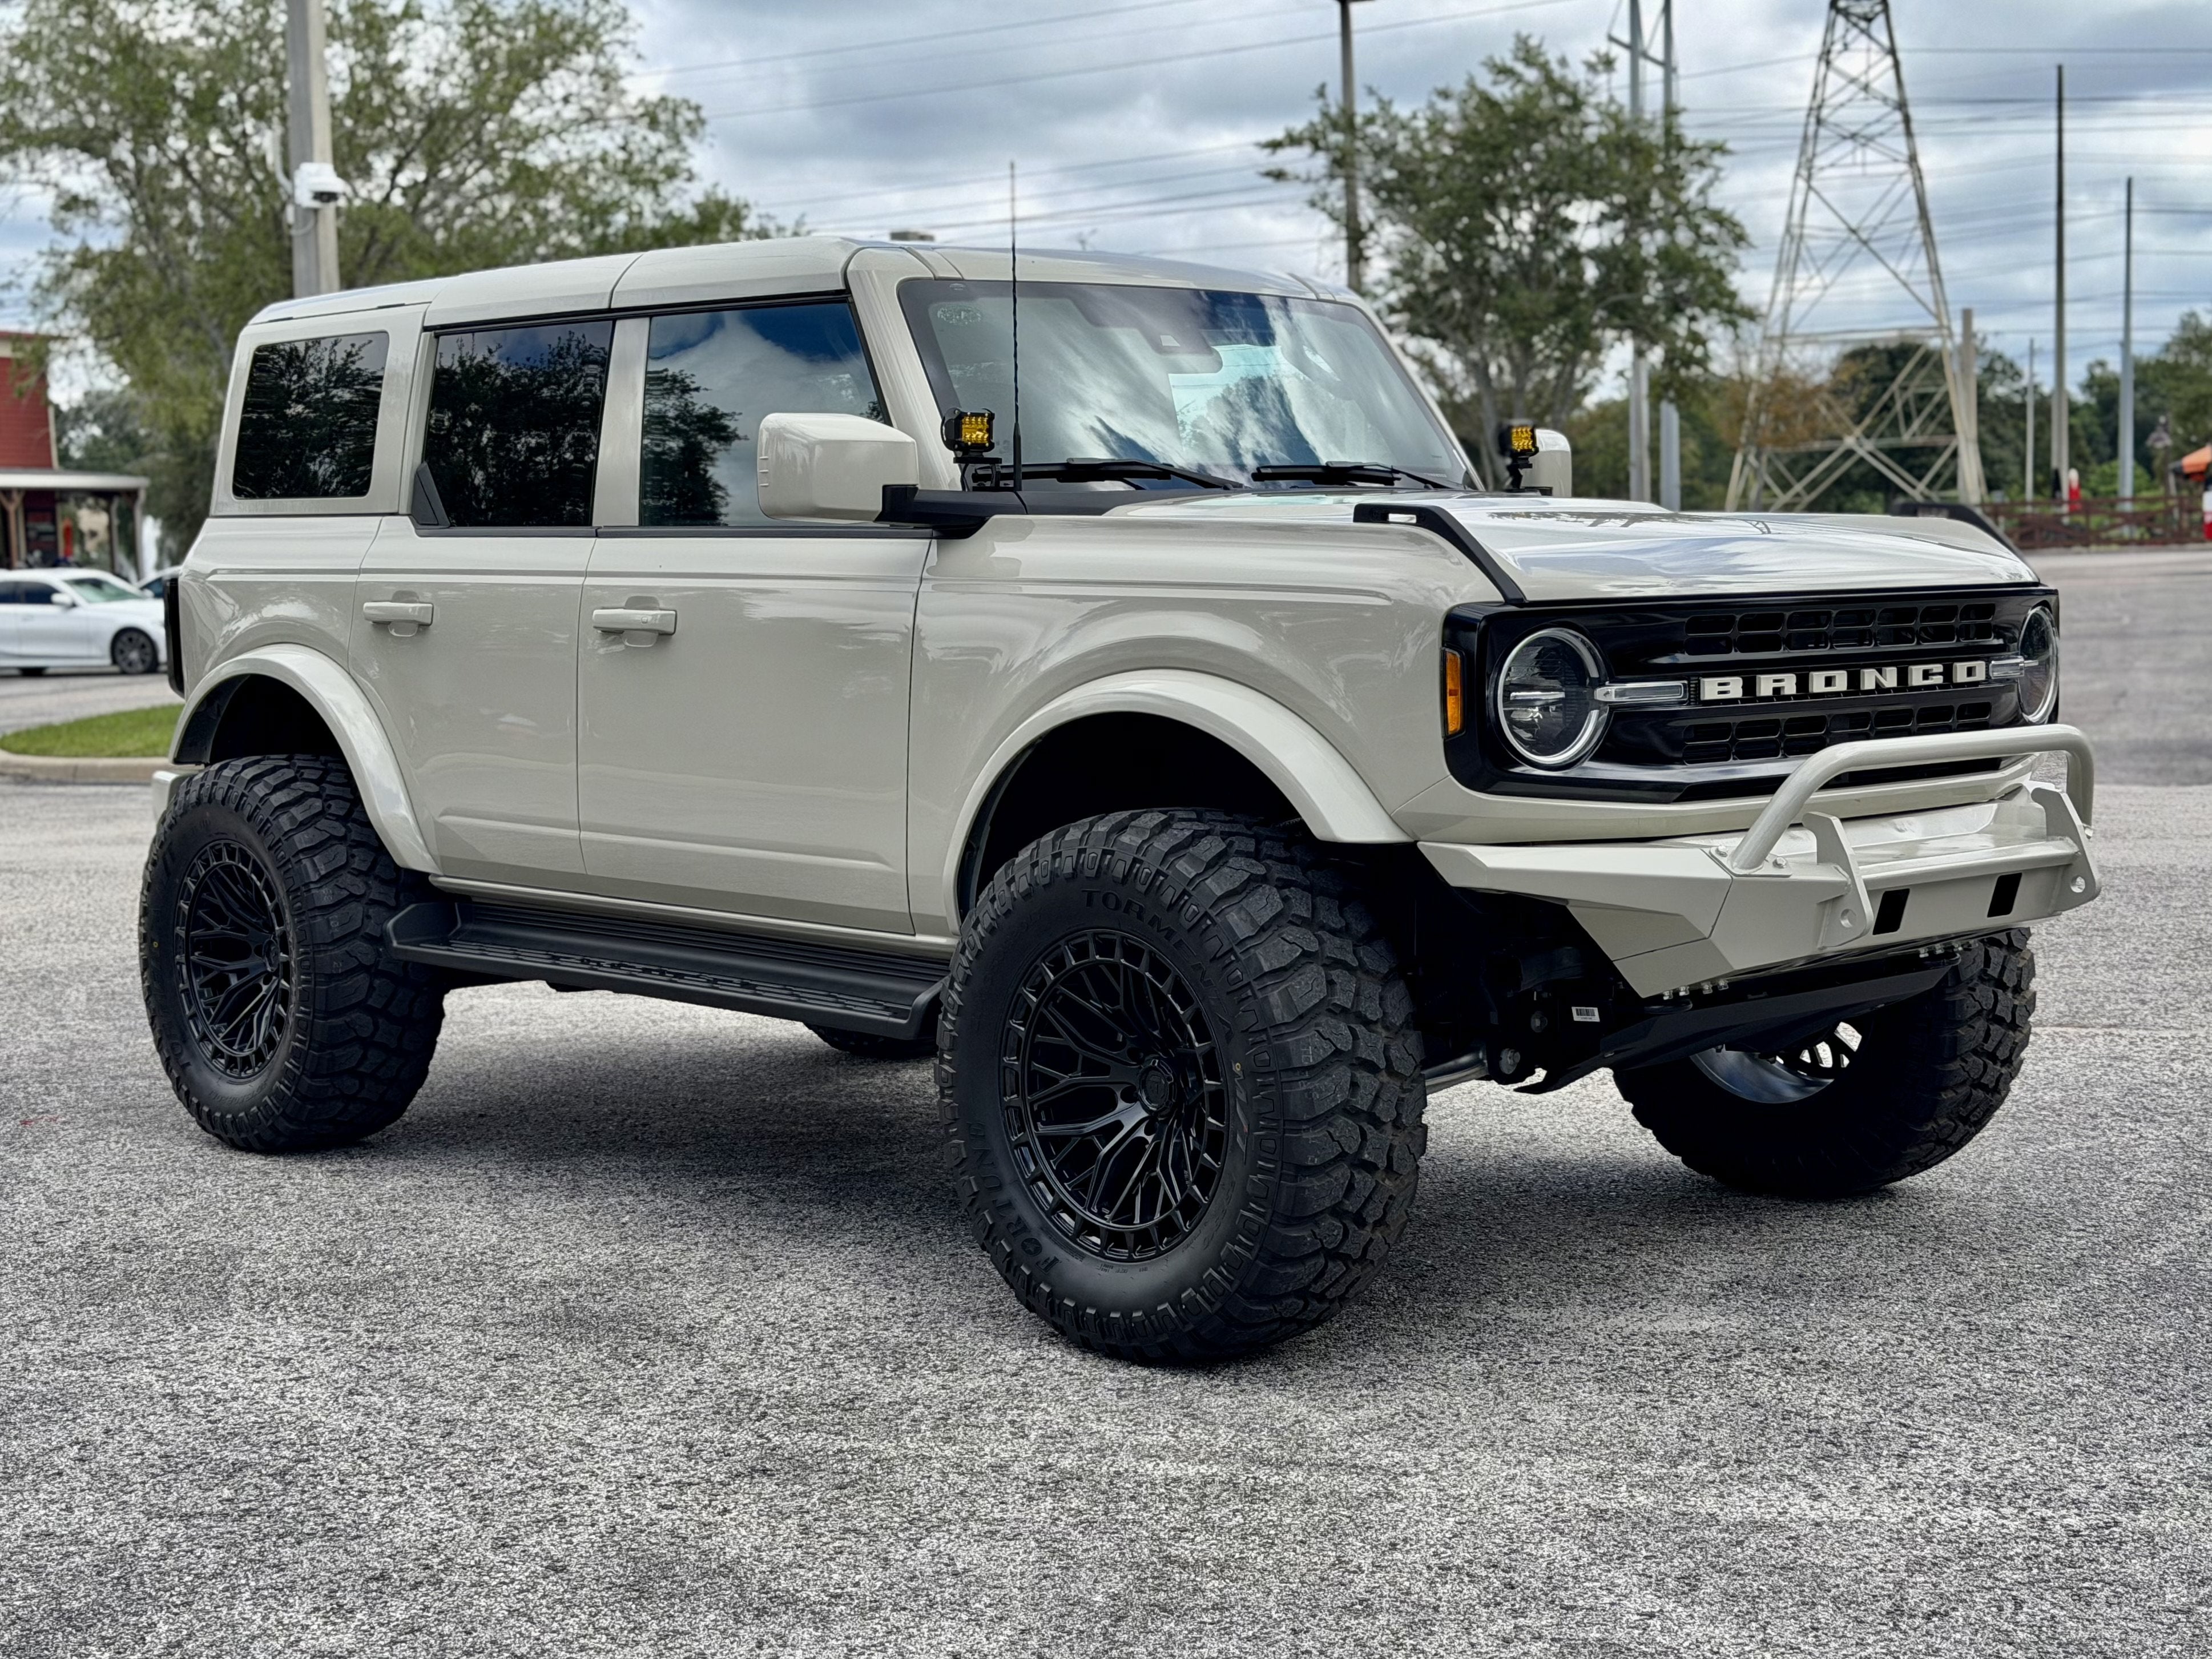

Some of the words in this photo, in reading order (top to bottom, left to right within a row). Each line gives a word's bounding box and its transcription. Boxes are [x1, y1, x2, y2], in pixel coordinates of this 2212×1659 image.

[1700, 661, 1986, 701] BRONCO
[1081, 888, 1234, 1042] TORMENTA
[967, 1121, 1062, 1275] FORTUNE
